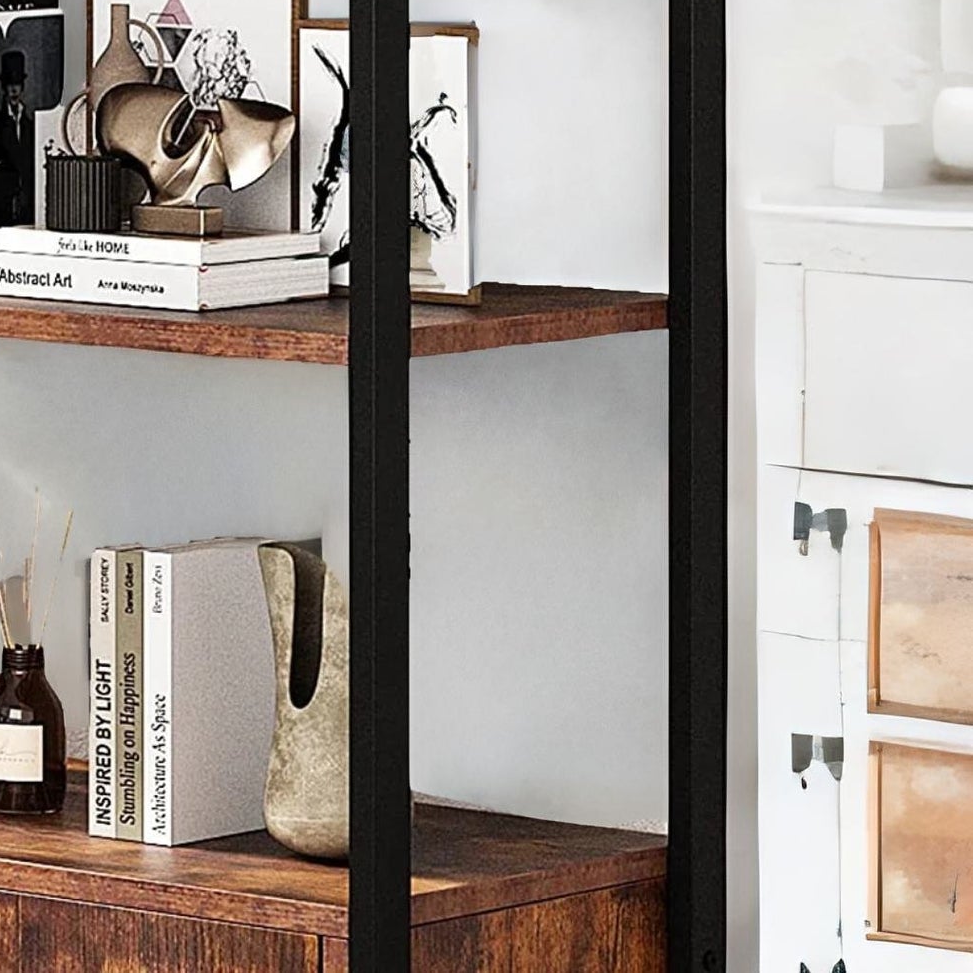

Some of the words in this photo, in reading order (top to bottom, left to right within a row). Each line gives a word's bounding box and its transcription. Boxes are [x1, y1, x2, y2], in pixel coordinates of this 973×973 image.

[95, 240, 130, 255] HOME
[52, 272, 73, 289] Art
[97, 279, 119, 290] Anna
[100, 558, 110, 595] STOREY
[100, 595, 110, 623] SALLY
[95, 658, 112, 711] LIGHT
[119, 652, 140, 727] Happiness
[95, 714, 112, 740] BY
[150, 693, 169, 733] Space
[123, 729, 136, 748] on
[151, 735, 167, 753] As
[95, 743, 112, 826] INSPIRED
[119, 750, 139, 826] Stumbling
[150, 756, 167, 835] Architecture
